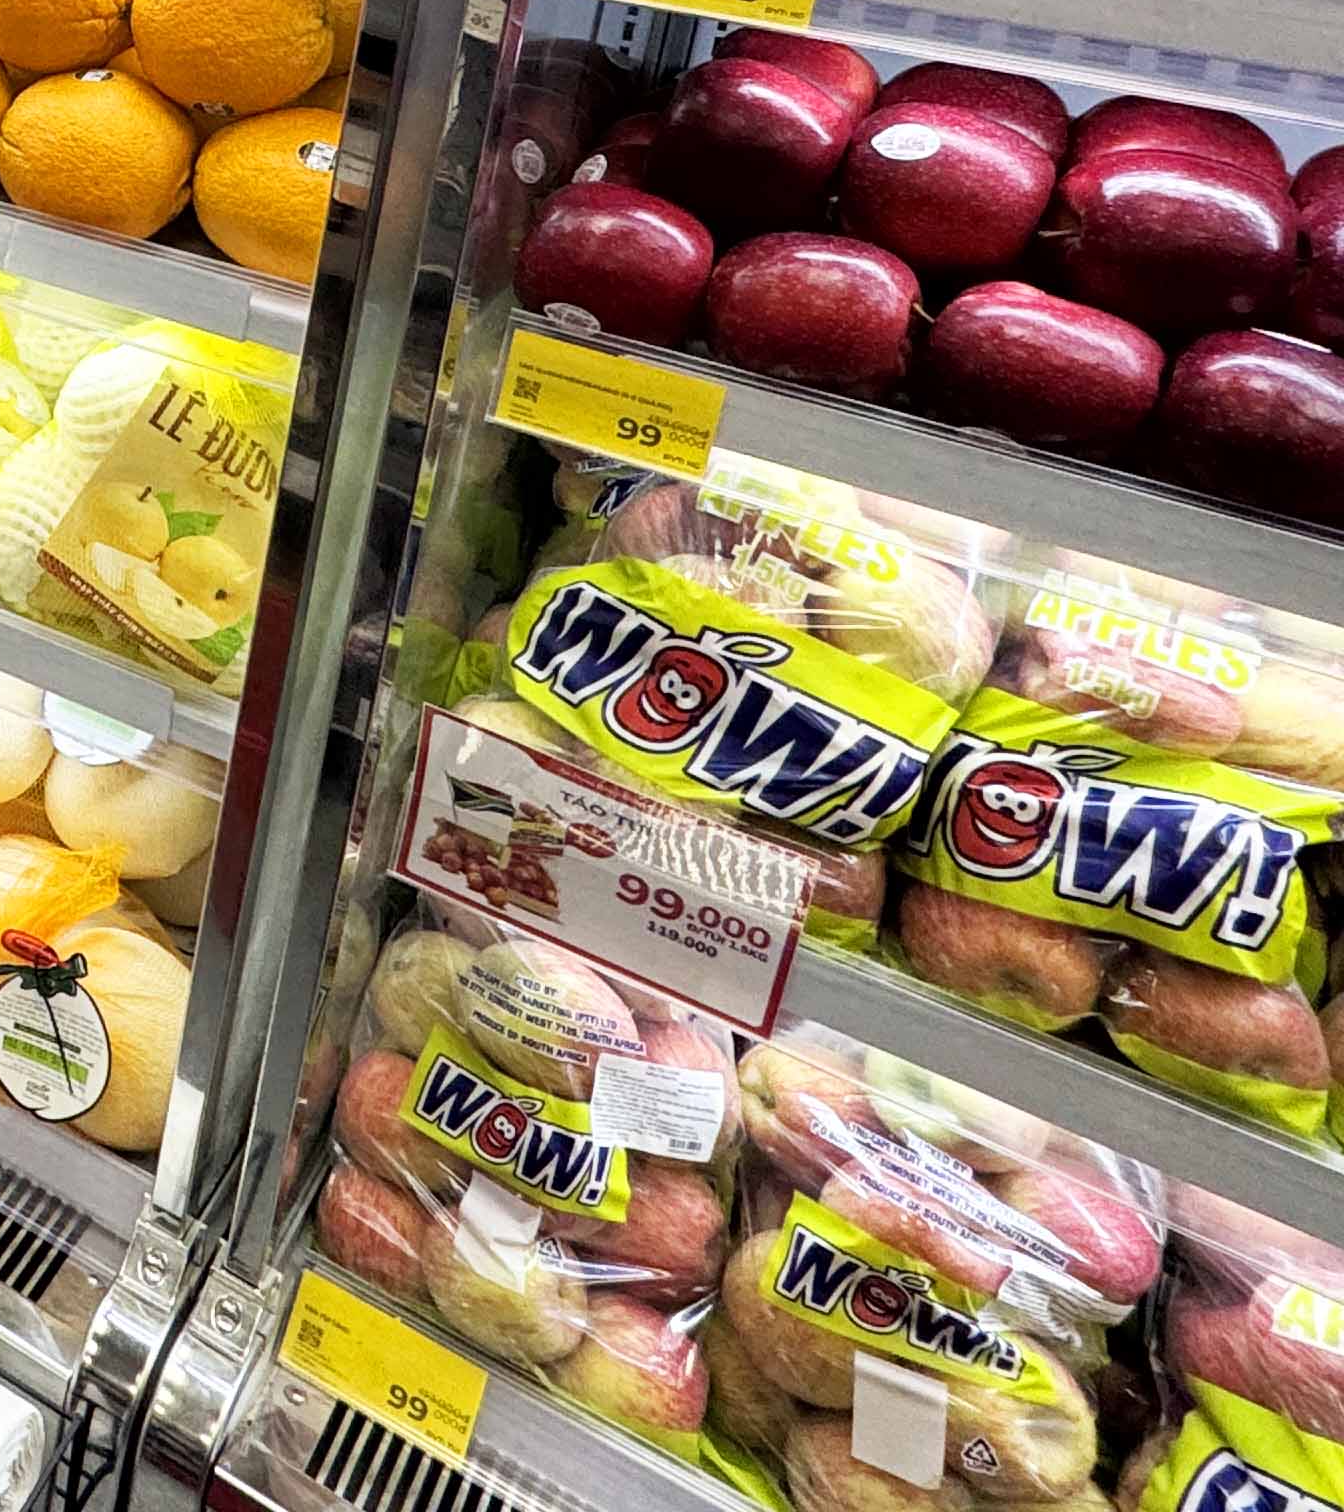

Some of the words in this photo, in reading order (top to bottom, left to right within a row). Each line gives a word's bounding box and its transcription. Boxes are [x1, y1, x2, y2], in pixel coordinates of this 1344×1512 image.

[148, 382, 208, 444] LÊ
[616, 416, 662, 448] 99
[697, 465, 912, 585] APPLES
[732, 543, 812, 605] 1.5kg
[1024, 588, 1262, 695] APPLES
[515, 582, 929, 844] WOW!
[1065, 658, 1162, 720] 1.5kg
[560, 789, 609, 820] TÁO
[616, 872, 770, 948] 99.000
[646, 919, 718, 959] 119.000
[521, 1035, 554, 1055] SOUTH
[556, 1048, 588, 1064] AFRICA
[526, 1014, 552, 1030] WEST
[583, 1030, 612, 1046] SOUTH
[614, 1037, 644, 1053] AFRICA
[415, 1054, 616, 1207] WOW!
[859, 1173, 905, 1205] PRODUCE
[386, 1384, 429, 1420] 99
